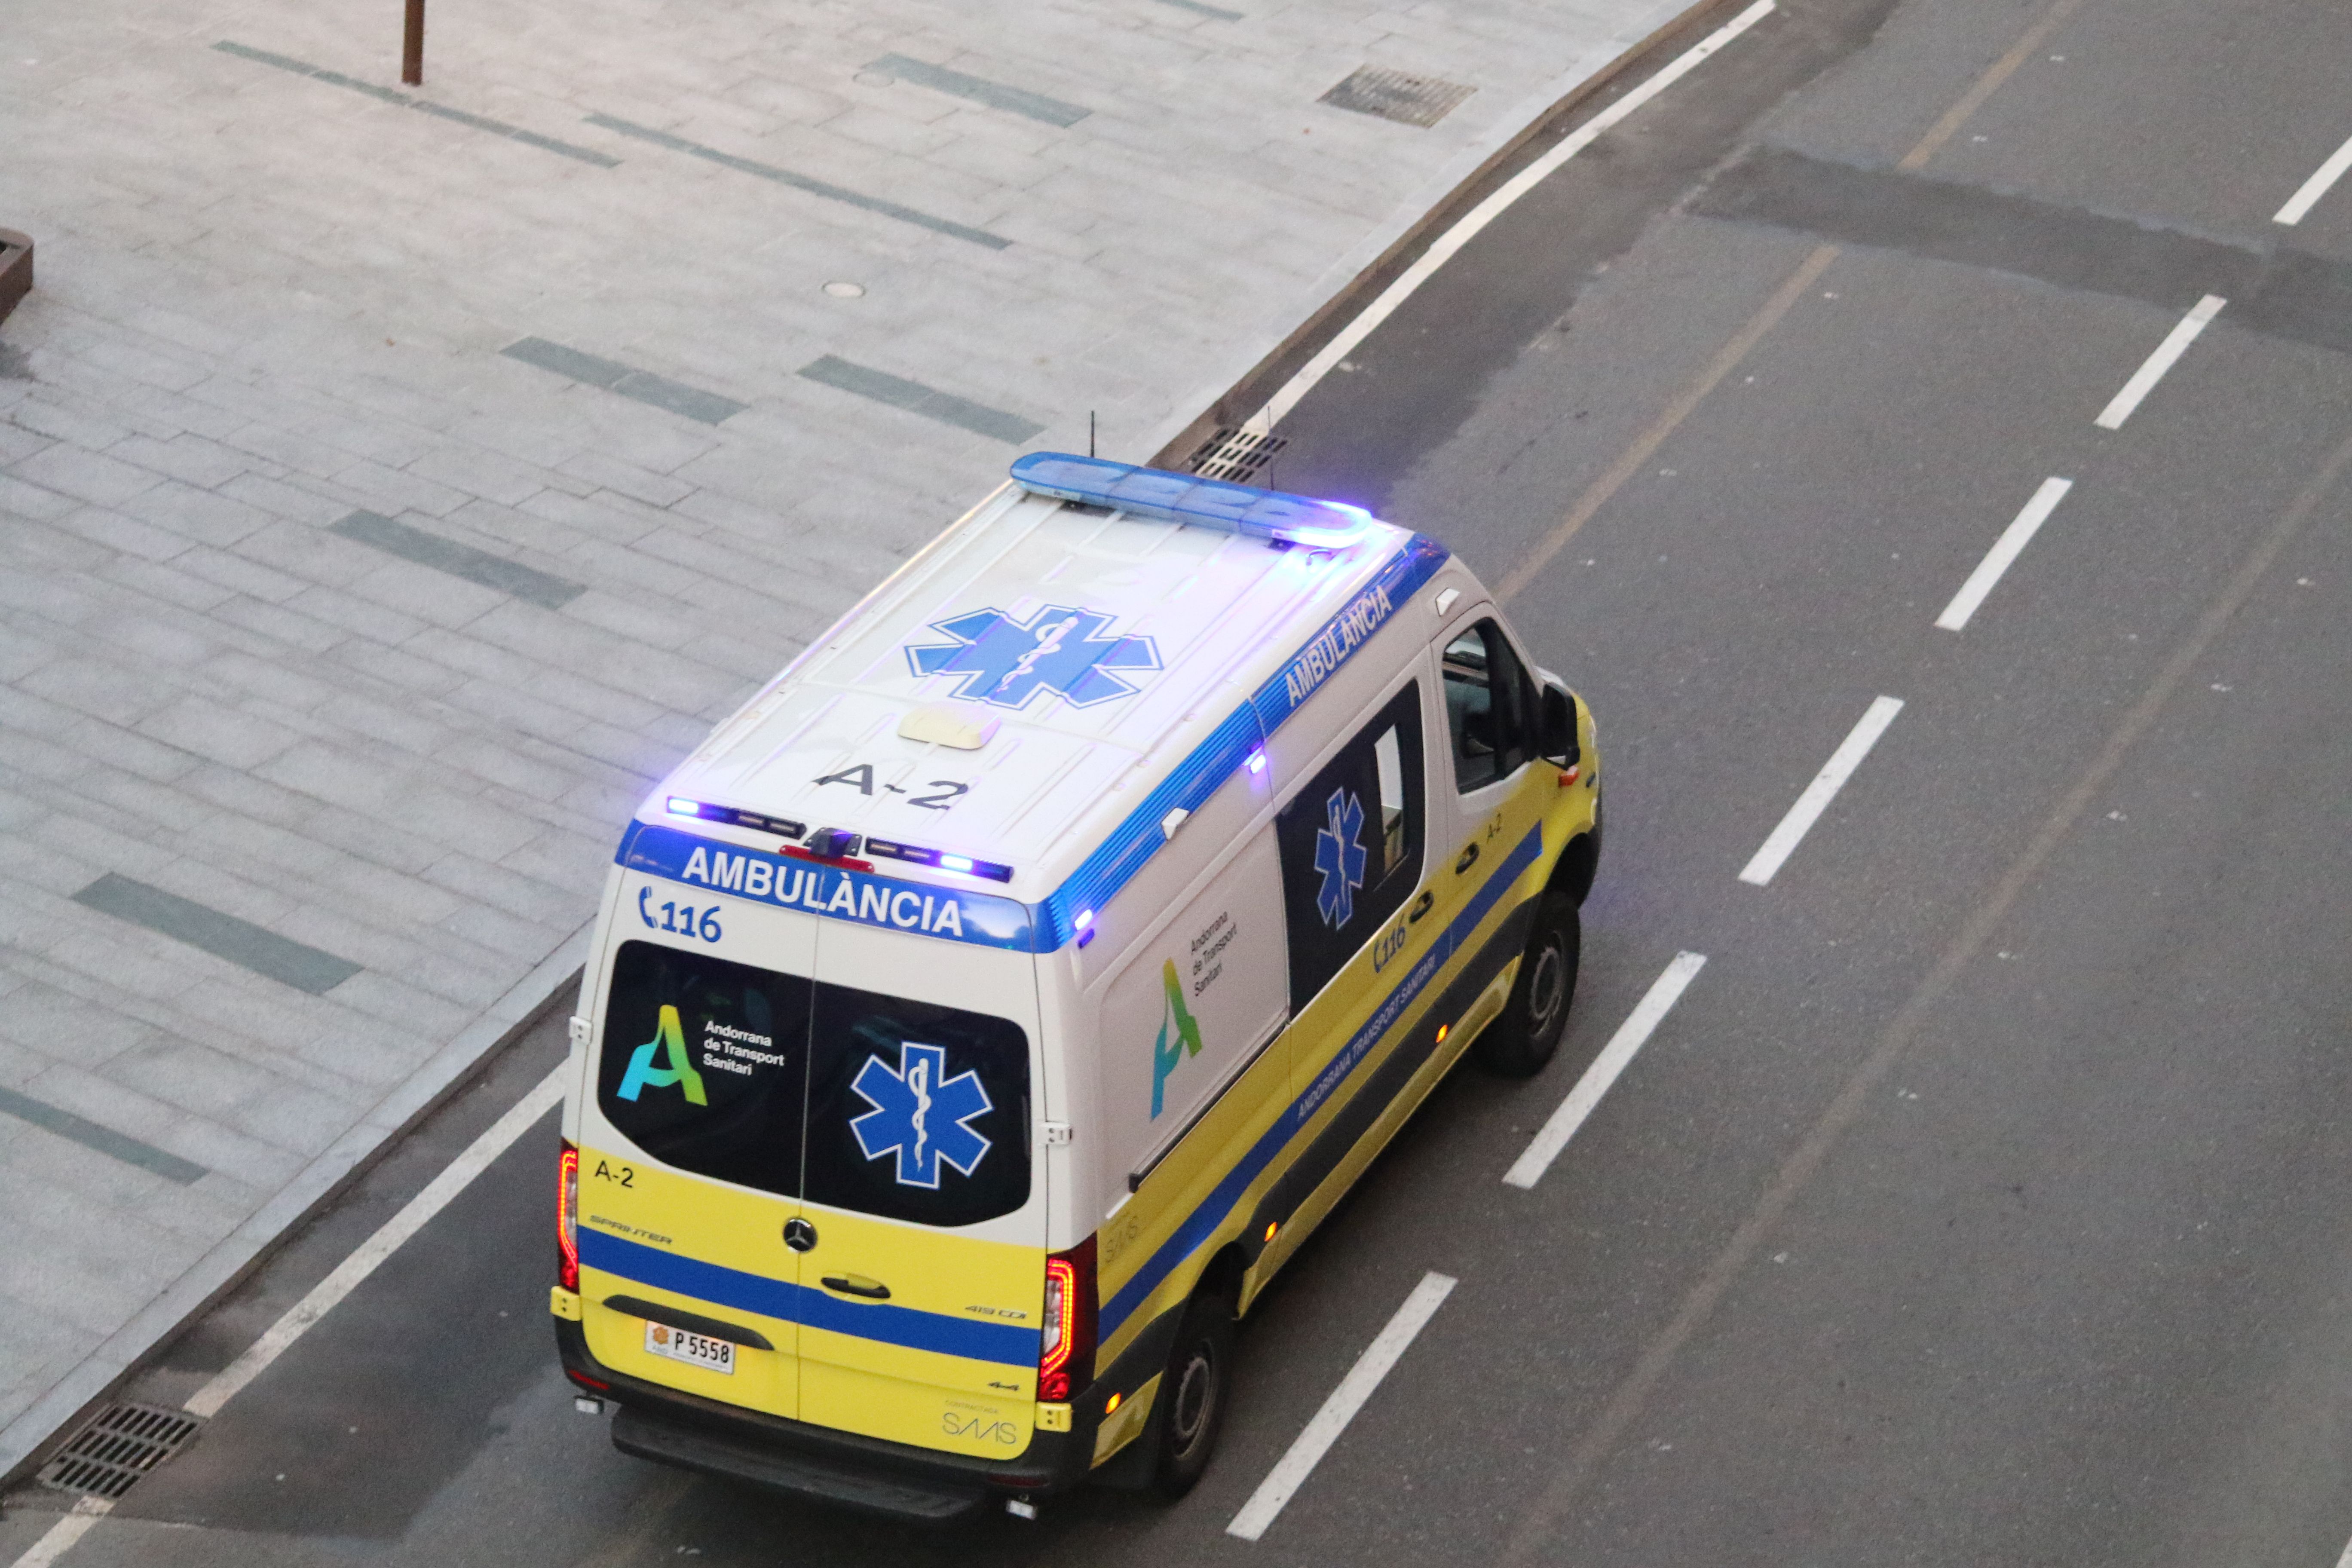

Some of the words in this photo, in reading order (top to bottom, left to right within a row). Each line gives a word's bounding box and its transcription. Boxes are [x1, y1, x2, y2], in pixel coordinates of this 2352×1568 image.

[812, 763, 968, 810] A-2
[1486, 812, 1501, 844] A-2
[682, 846, 963, 937] AMBULÀNCIA
[661, 901, 722, 943] 116
[1191, 910, 1228, 956] Andorrana
[1382, 913, 1406, 968] 116
[1193, 959, 1202, 976] de
[1203, 922, 1237, 965] Transport
[1194, 960, 1222, 997] Sanitari
[703, 1037, 721, 1051] de
[722, 1040, 785, 1066] Transport
[704, 1020, 772, 1047] Andorrana
[1297, 1052, 1351, 1121] ANDORRANA
[1352, 994, 1400, 1059] TRANSPORT
[1400, 953, 1435, 1004] SANITARI
[702, 1053, 753, 1076] Sanitari
[594, 1160, 634, 1188] A-2
[589, 1215, 673, 1245] SPRINTER
[674, 1332, 684, 1350] P
[689, 1335, 729, 1363] 5558
